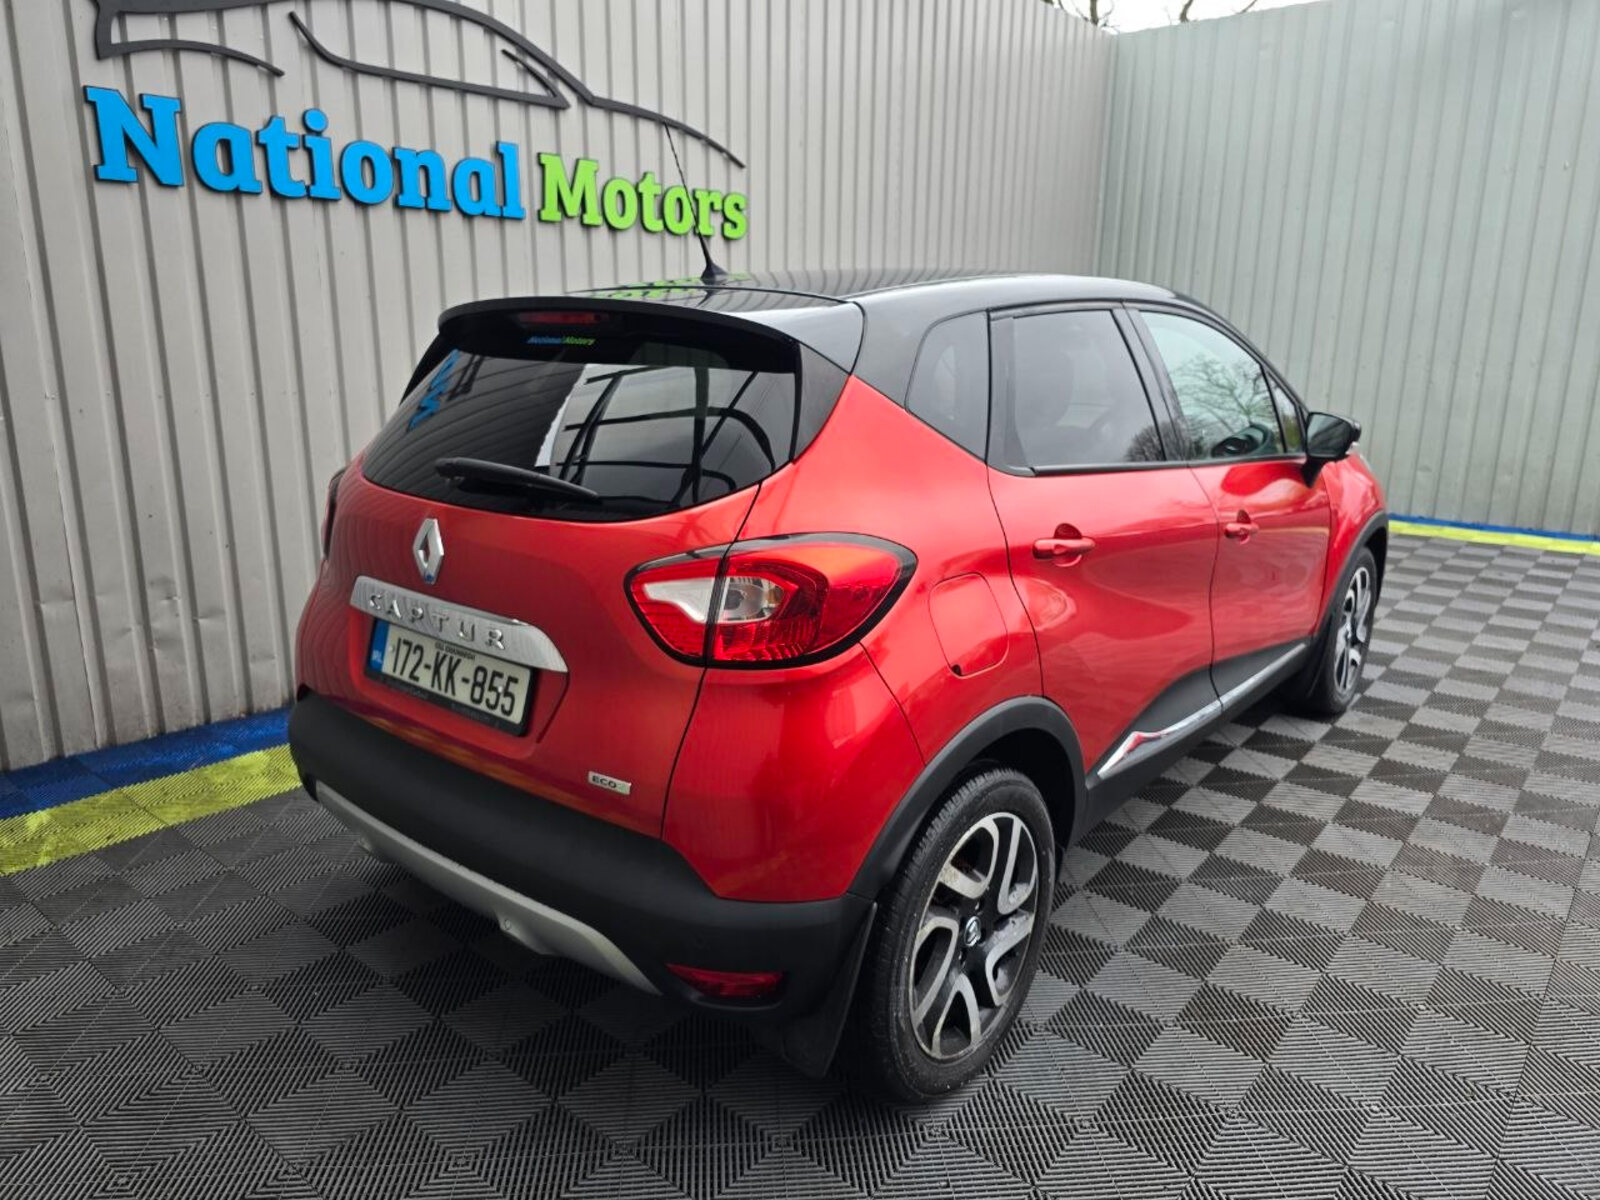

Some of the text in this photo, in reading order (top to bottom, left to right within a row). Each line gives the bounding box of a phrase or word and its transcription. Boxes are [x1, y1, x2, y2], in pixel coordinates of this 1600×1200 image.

[84, 86, 748, 240] National Motors
[391, 636, 520, 718] 172-KK-855
[591, 775, 617, 789] ECO
